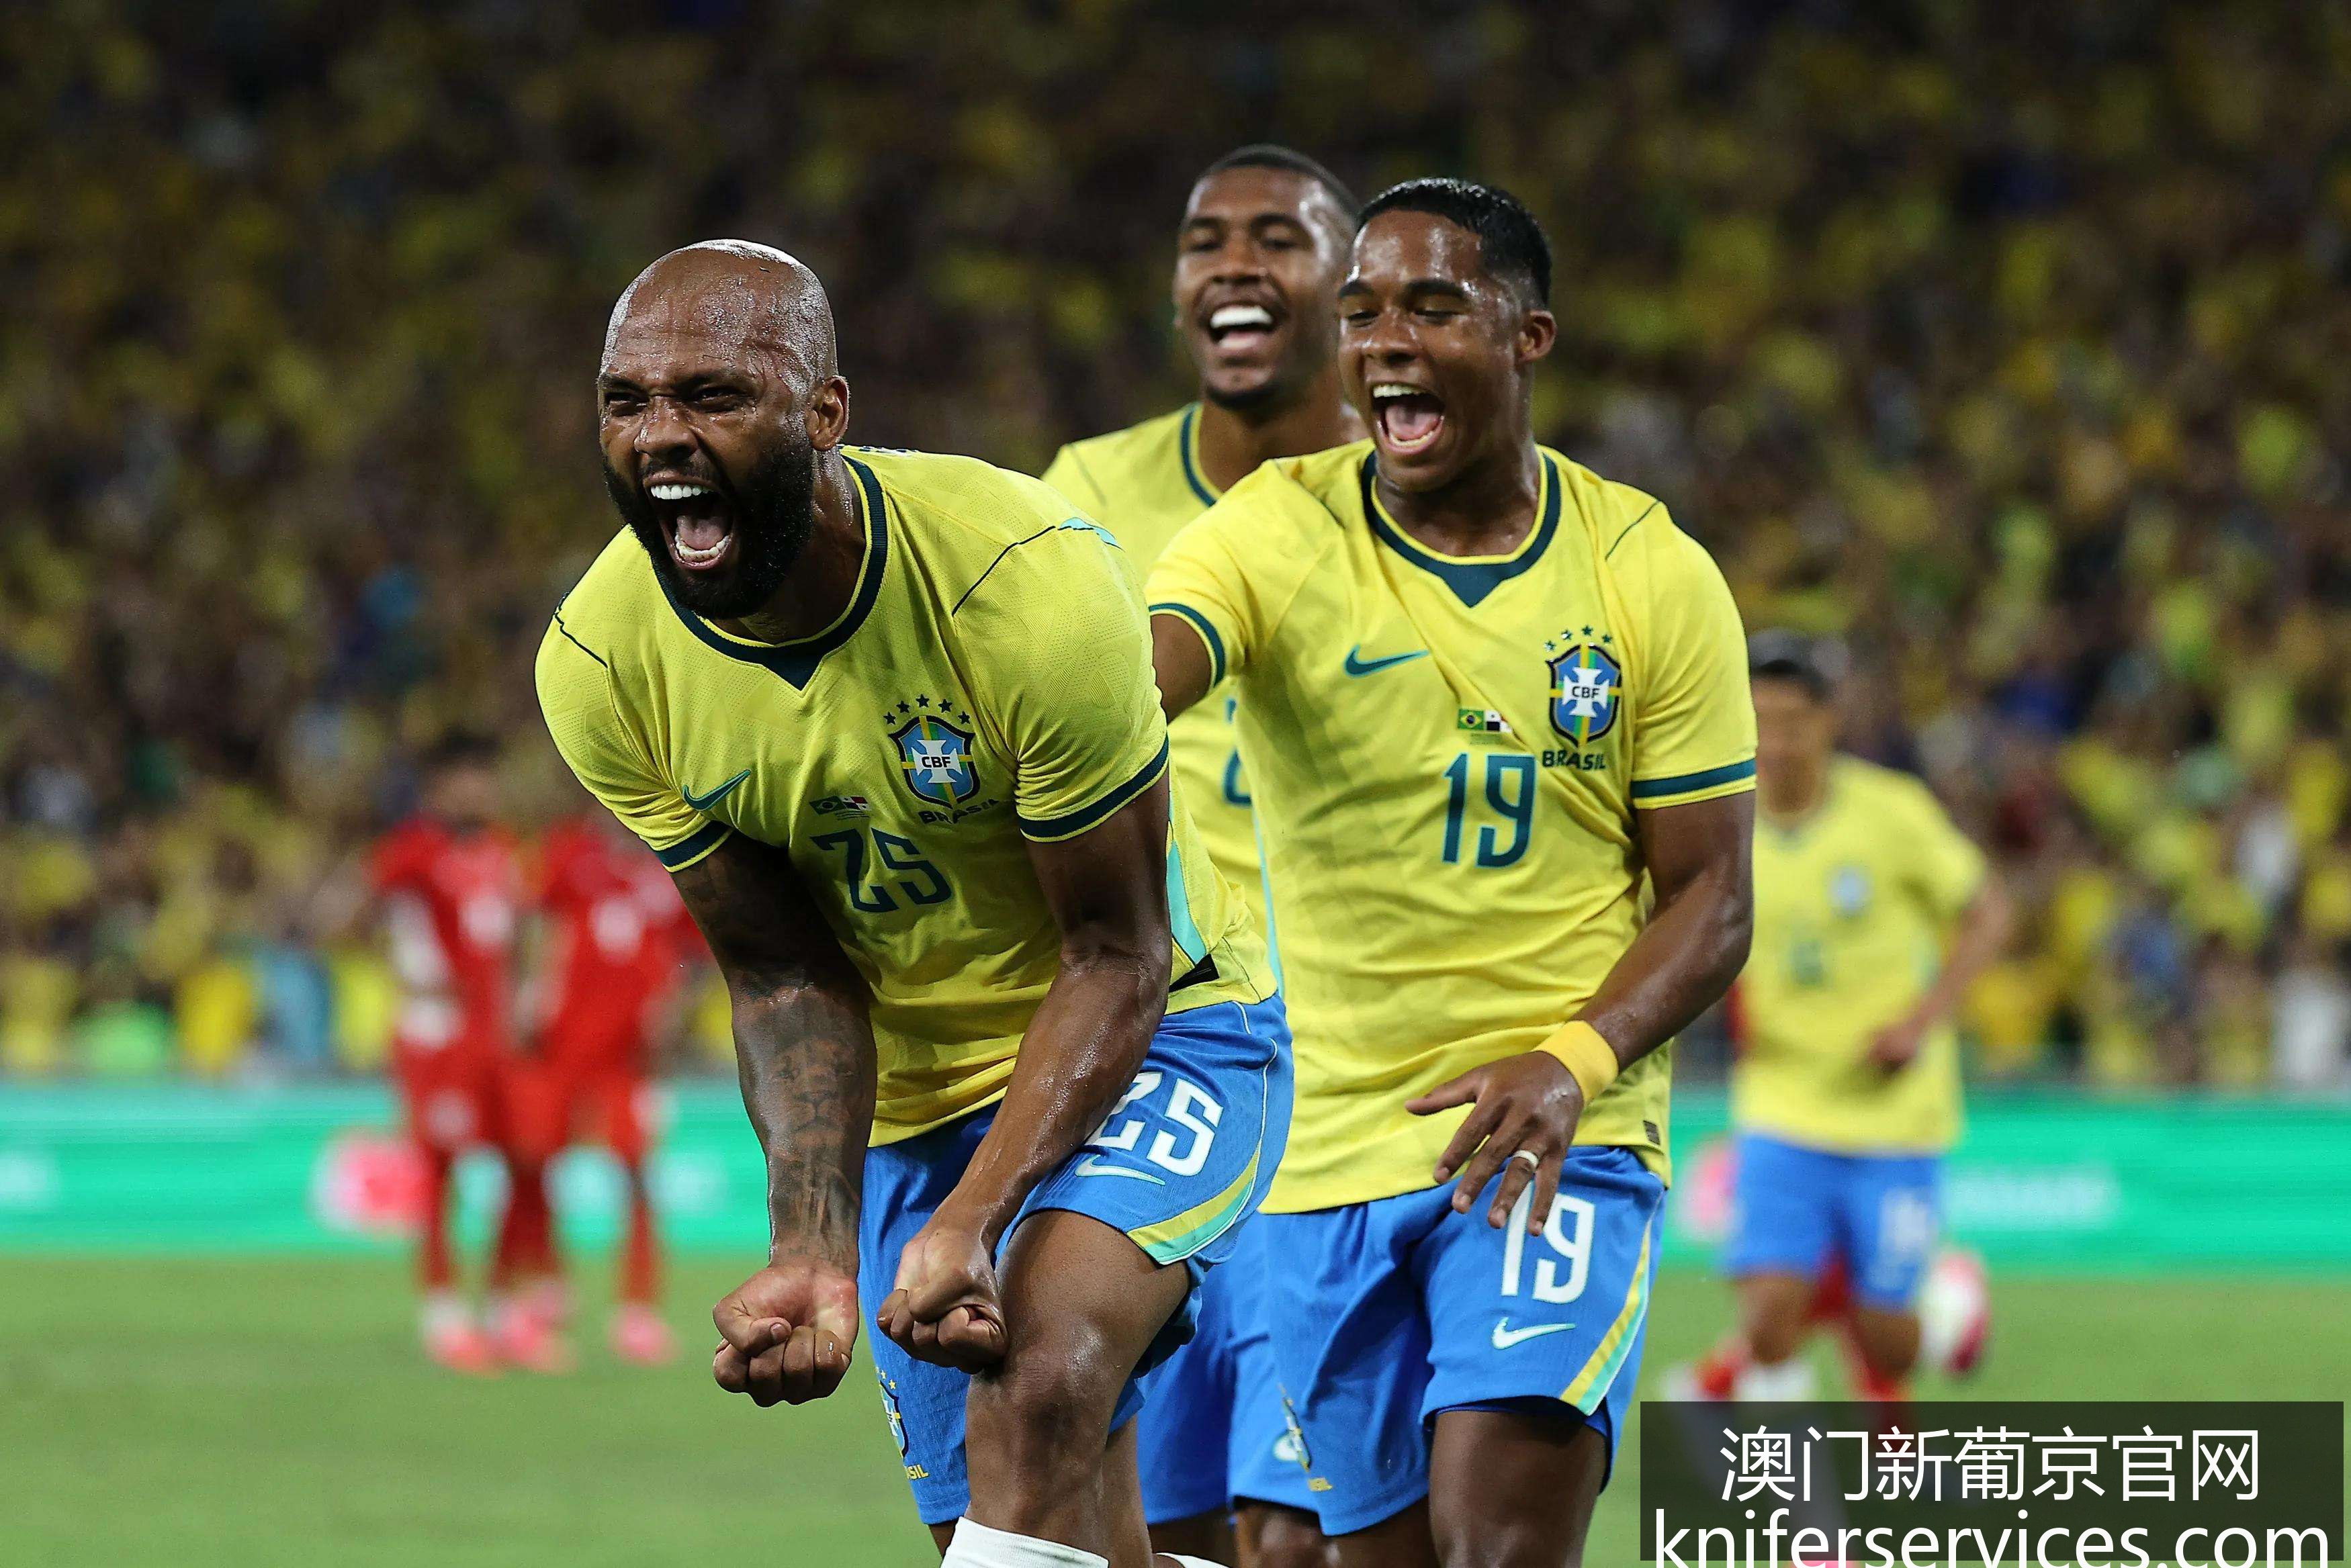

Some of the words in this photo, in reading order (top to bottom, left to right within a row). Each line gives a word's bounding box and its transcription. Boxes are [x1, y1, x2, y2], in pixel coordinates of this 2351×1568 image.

[1572, 686, 1600, 699] CBF
[922, 755, 951, 768] CBF
[1542, 749, 1607, 771] BRASIL
[918, 798, 1000, 825] BRASIL
[1442, 752, 1537, 868] 19
[809, 827, 952, 913] 25
[1084, 1072, 1224, 1177] 25
[1501, 1181, 1595, 1303] 19
[907, 1464, 930, 1480] SIL
